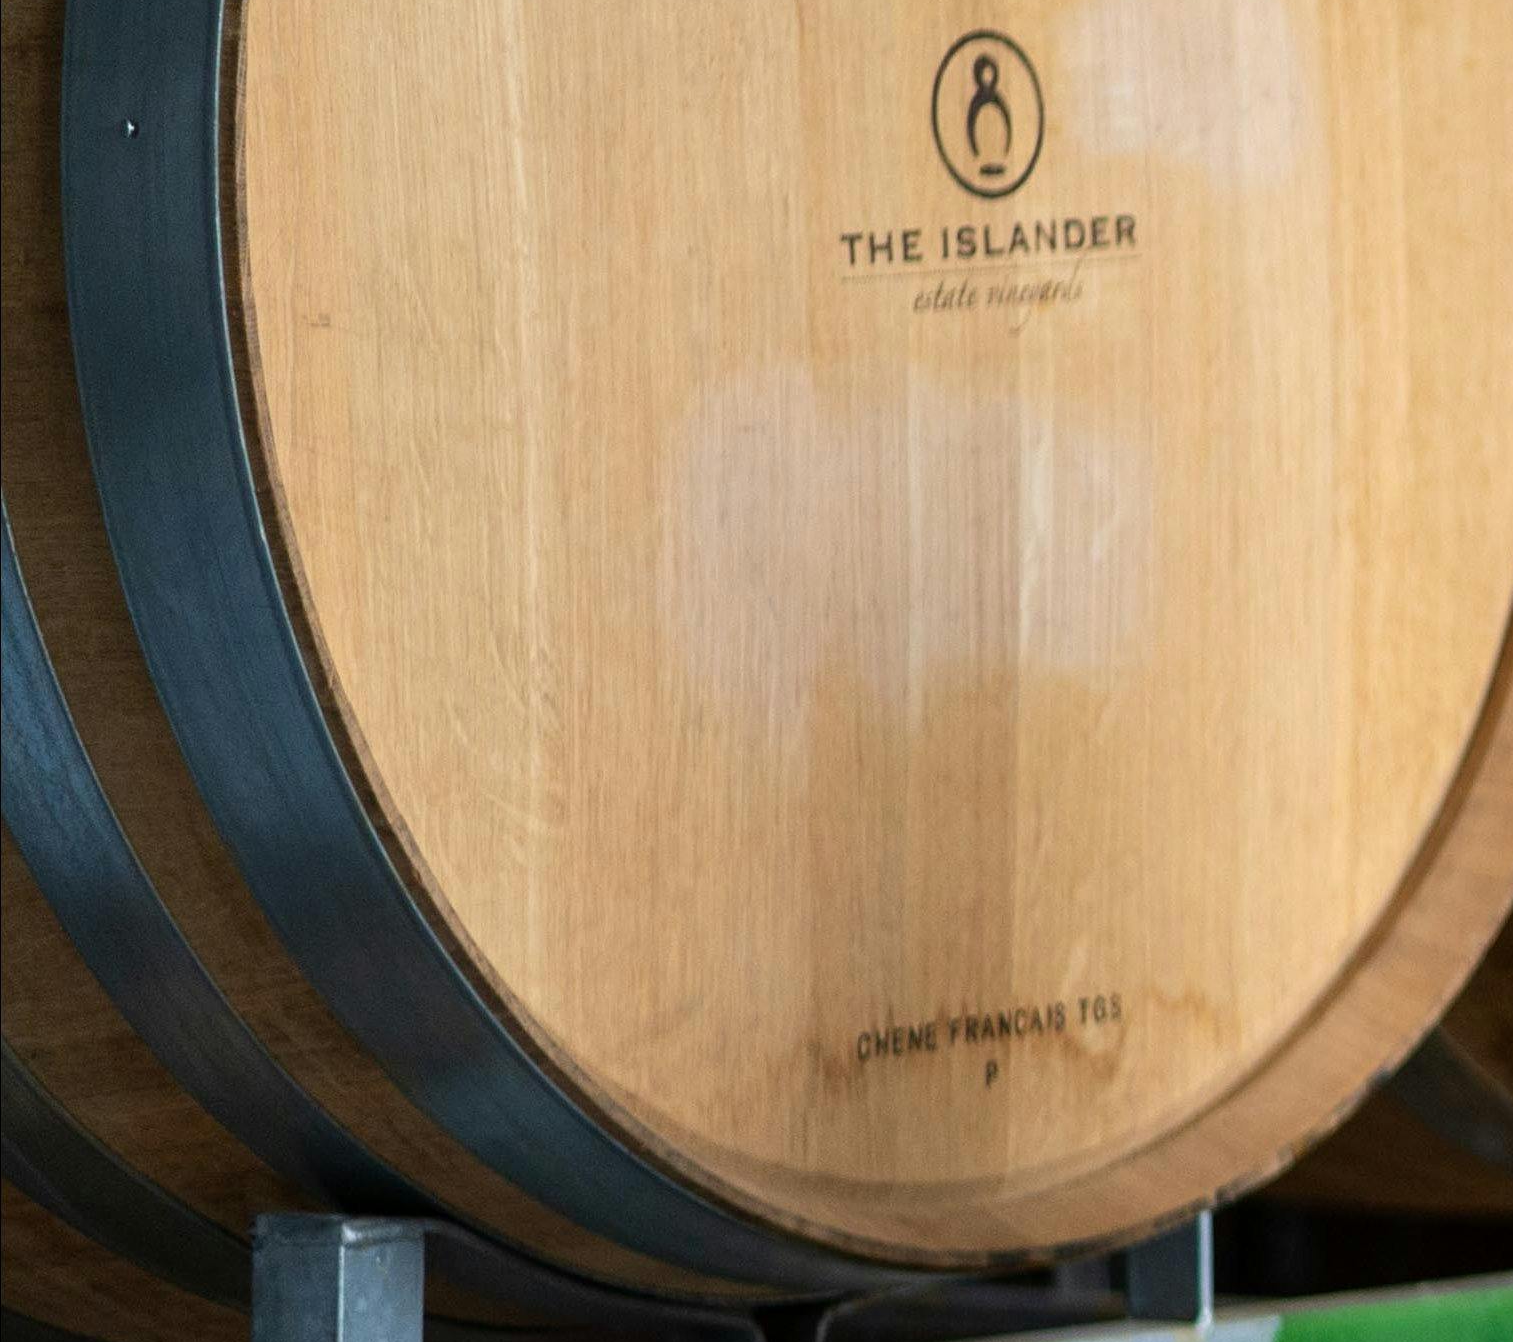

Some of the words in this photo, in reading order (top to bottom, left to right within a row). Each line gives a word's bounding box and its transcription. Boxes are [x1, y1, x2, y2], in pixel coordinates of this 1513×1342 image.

[841, 229, 923, 265] THE
[941, 214, 1137, 259] ISLANDER
[912, 279, 977, 314] estate
[857, 1020, 937, 1060] CHENE
[947, 1000, 1066, 1047] FRANCAIS
[984, 1059, 998, 1089] P
